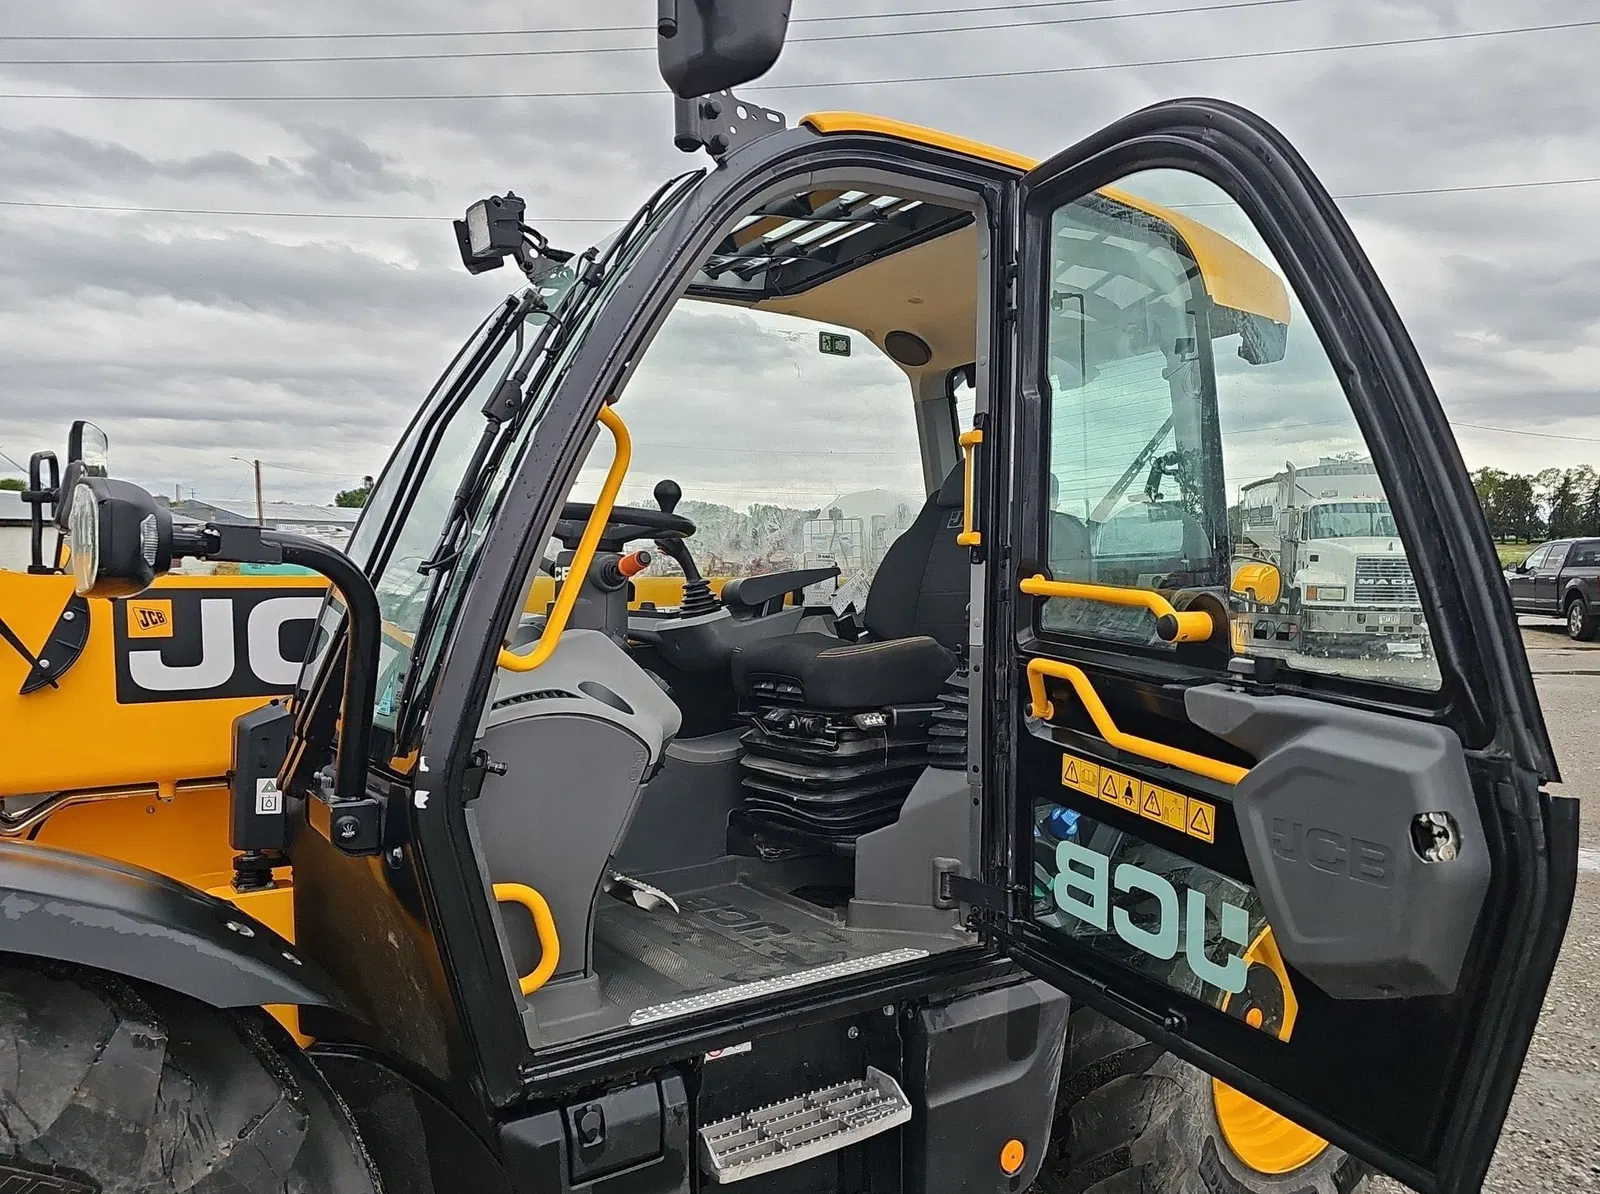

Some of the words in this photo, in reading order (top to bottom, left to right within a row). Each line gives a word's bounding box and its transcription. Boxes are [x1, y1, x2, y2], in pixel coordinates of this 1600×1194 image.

[128, 597, 345, 691] JC
[139, 609, 165, 628] JCB
[1272, 815, 1396, 890] JCB
